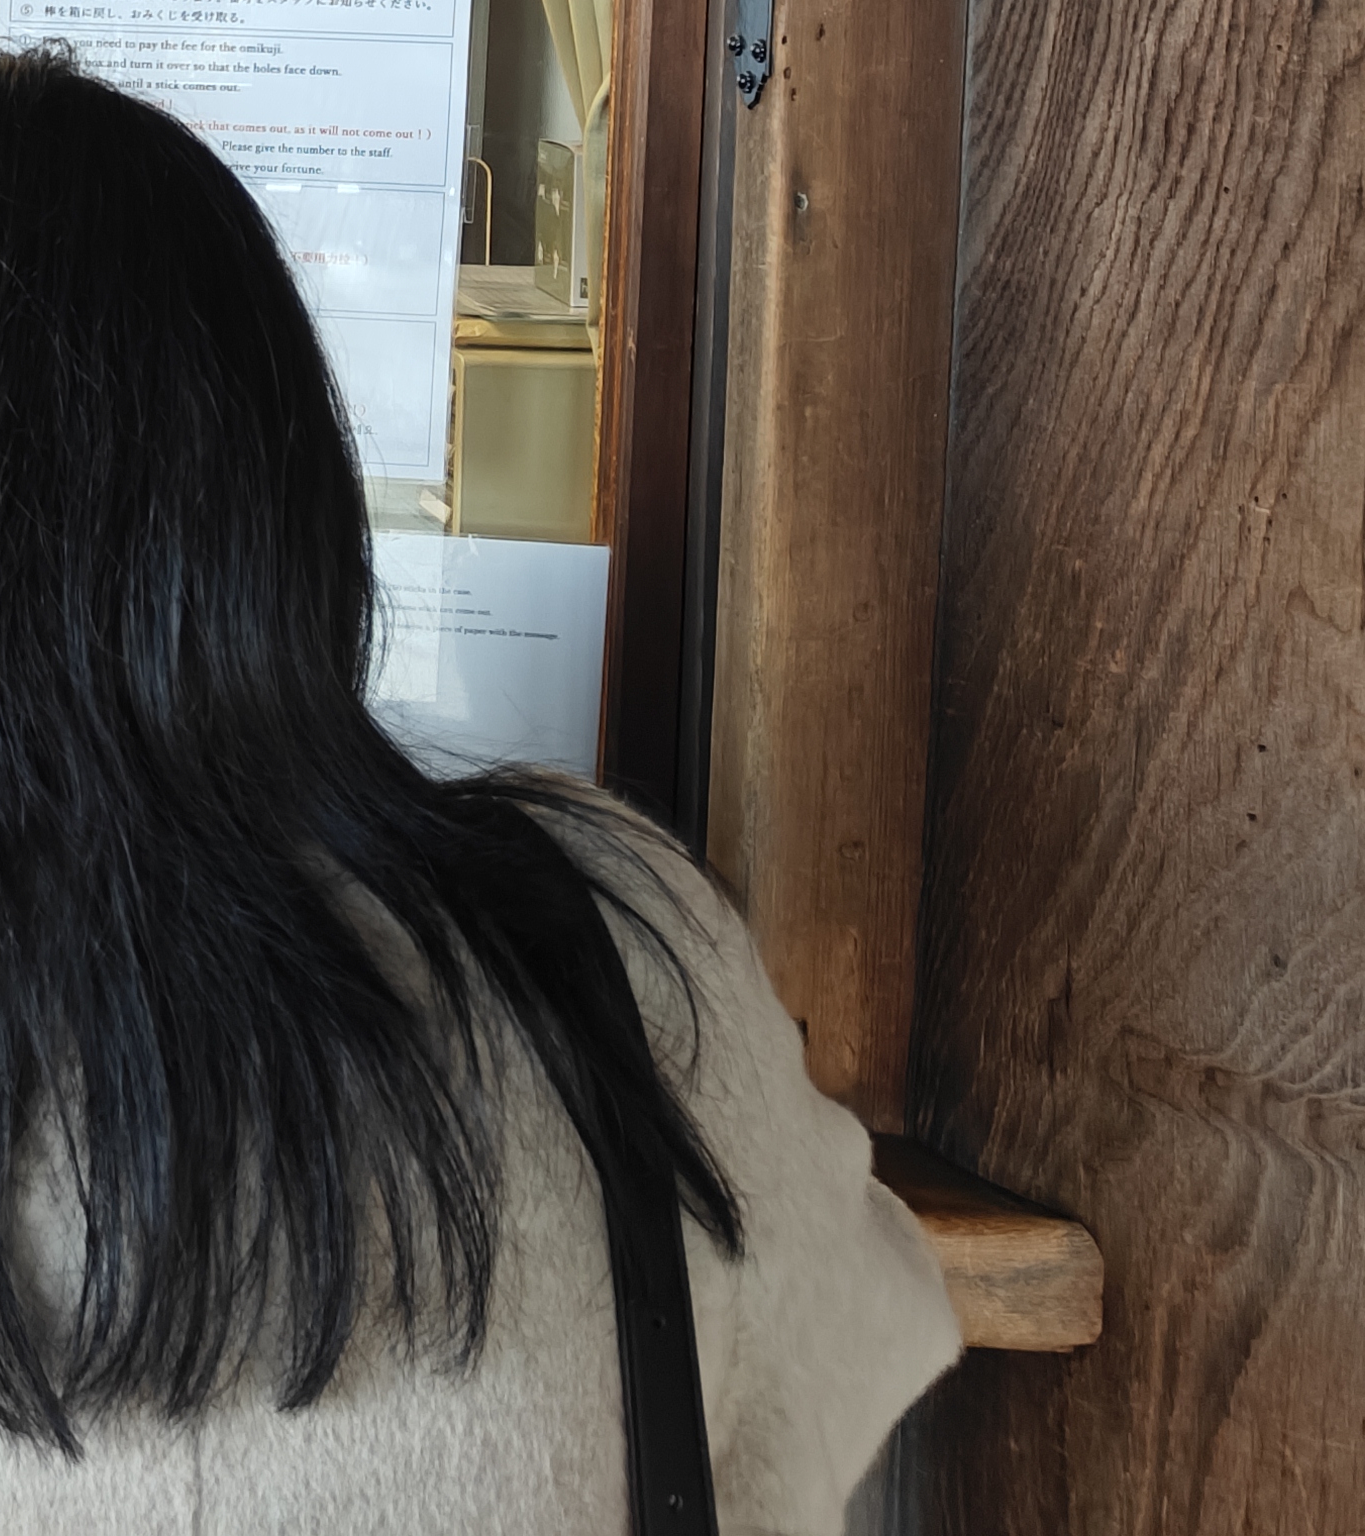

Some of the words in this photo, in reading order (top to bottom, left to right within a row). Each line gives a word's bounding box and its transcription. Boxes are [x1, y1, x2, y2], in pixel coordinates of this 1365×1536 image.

[96, 35, 122, 48] need
[125, 37, 136, 48] to
[138, 39, 158, 52] pay
[160, 37, 179, 50] the
[181, 38, 197, 50] fee
[200, 41, 216, 52] for
[219, 42, 236, 52] the
[239, 43, 283, 56] omikuji.
[106, 58, 127, 68] and
[130, 59, 152, 69] turn
[156, 59, 163, 69] it
[166, 62, 190, 70] over
[193, 63, 205, 71] so
[208, 62, 230, 72] that
[233, 62, 250, 73] the
[253, 63, 281, 74] holes
[284, 64, 306, 75] face
[309, 65, 342, 76] down.
[146, 81, 152, 89] a
[155, 79, 180, 90] stick
[182, 83, 217, 91] comes
[219, 84, 241, 92] out.
[208, 120, 229, 131] that
[233, 123, 267, 133] comes
[294, 124, 305, 134] as
[308, 125, 316, 135] it
[319, 125, 339, 136] will
[341, 128, 360, 137] not
[362, 129, 393, 138] come
[222, 140, 253, 151] Please
[255, 143, 275, 154] give
[278, 143, 294, 153] the
[296, 145, 334, 156] number
[337, 147, 348, 156] to
[350, 147, 366, 157] the
[369, 147, 393, 158] staff.
[253, 164, 279, 174] your
[282, 163, 324, 175] fortune.
